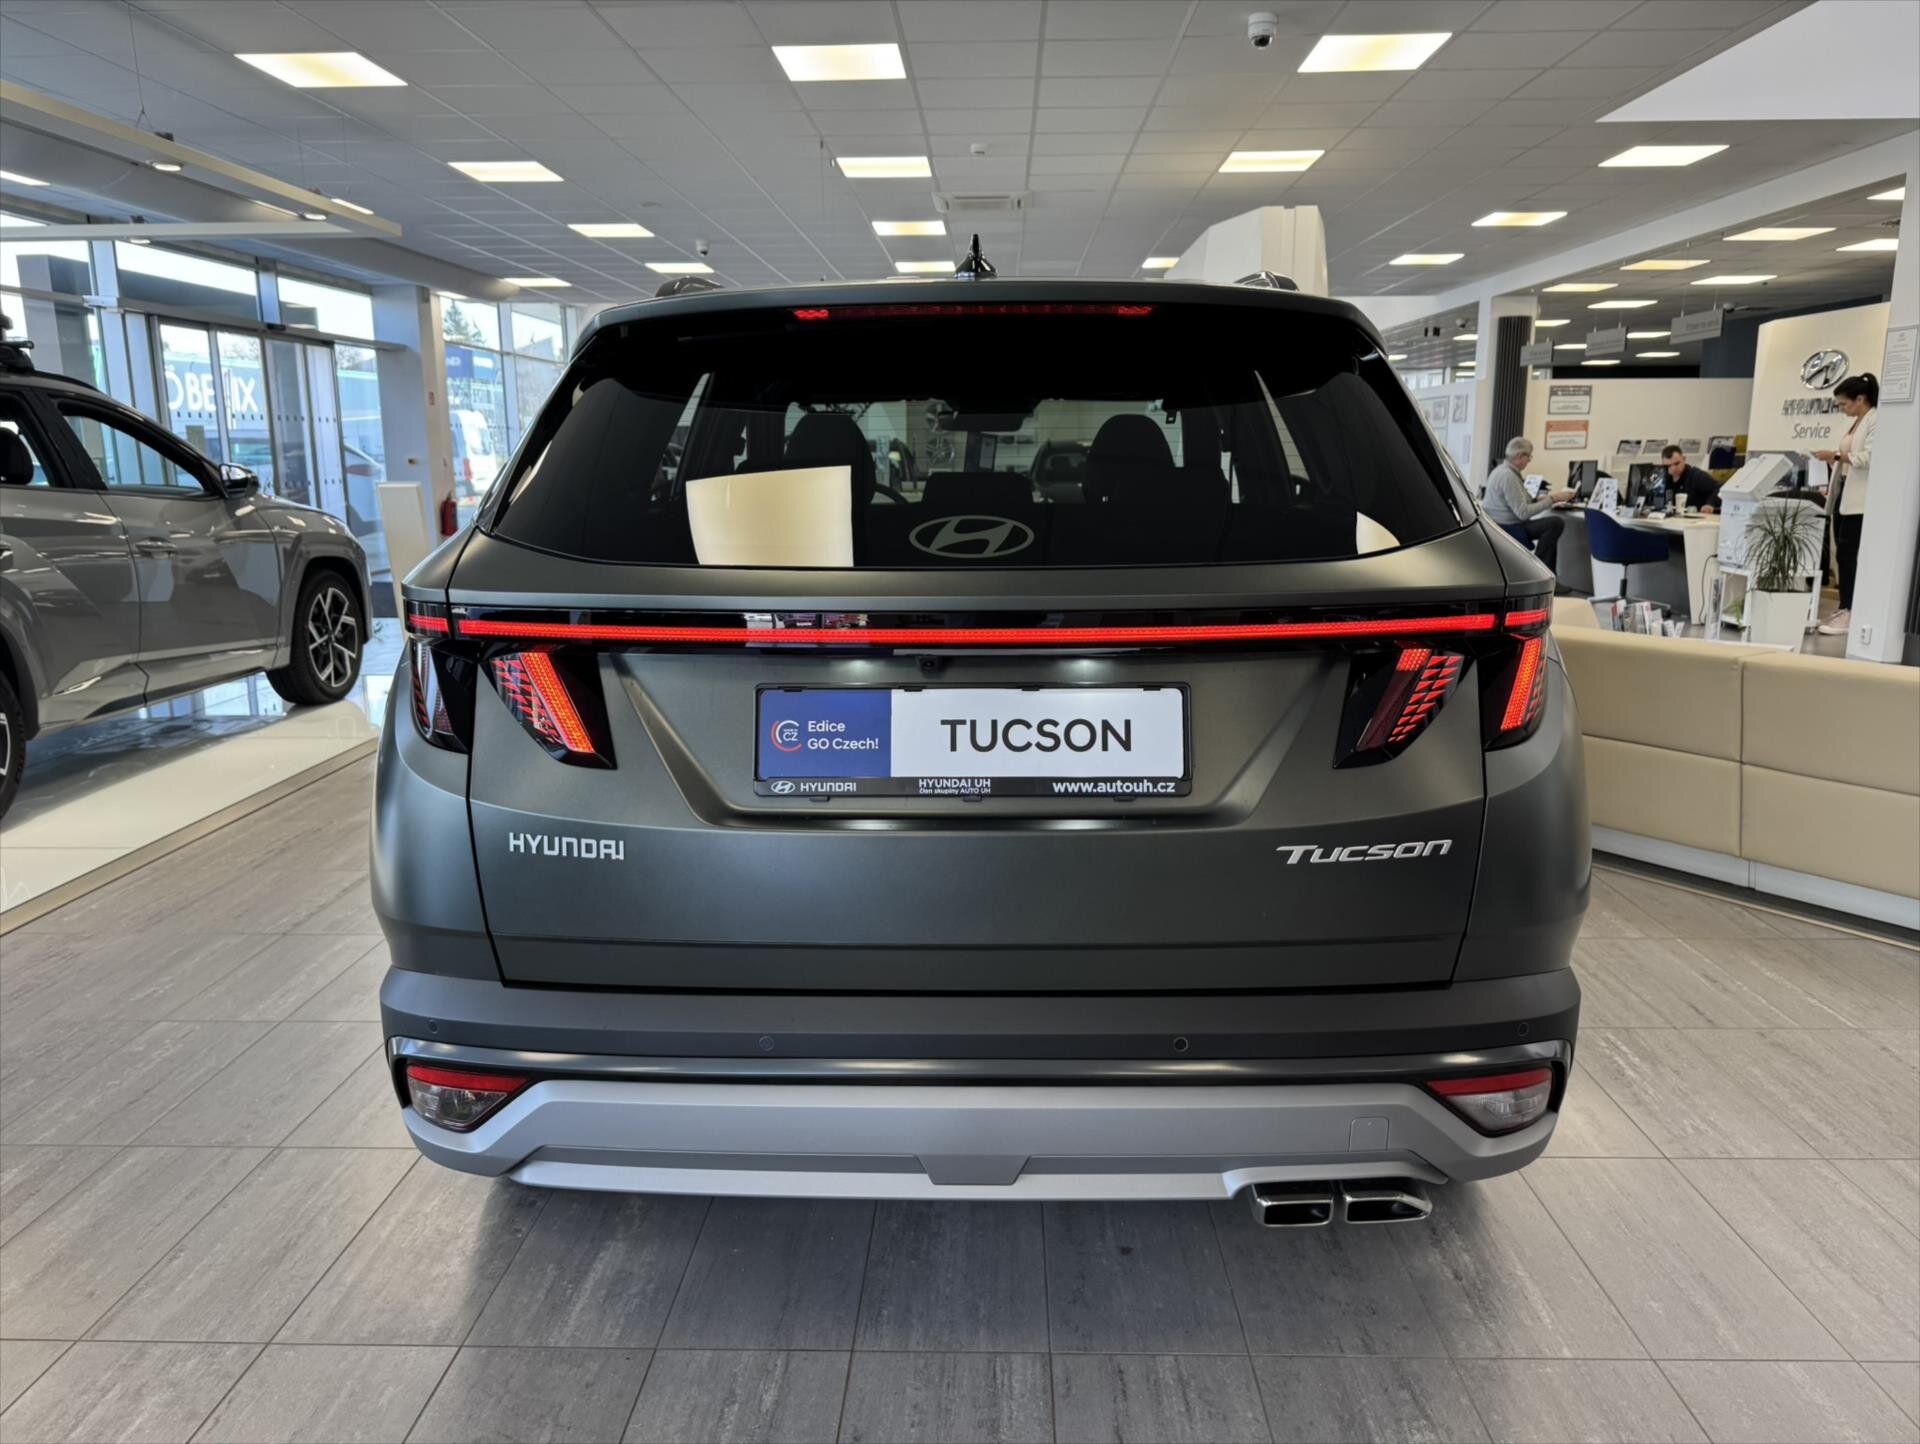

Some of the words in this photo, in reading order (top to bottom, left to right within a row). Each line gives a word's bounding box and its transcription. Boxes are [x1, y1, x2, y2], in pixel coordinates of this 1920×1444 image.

[1792, 422, 1831, 439] Service
[808, 720, 846, 733] Edice
[782, 732, 799, 741] CZ
[940, 718, 1132, 753] TUCSON
[807, 738, 830, 750] GO
[832, 737, 880, 750] Czech!
[800, 782, 857, 793] HYUNDAI
[919, 778, 971, 788] HYUNDAI
[974, 778, 991, 788] UH
[1052, 779, 1176, 793] www.autouh.cz
[509, 832, 625, 860] HYUNDAI
[1276, 839, 1453, 865] TUCSON
